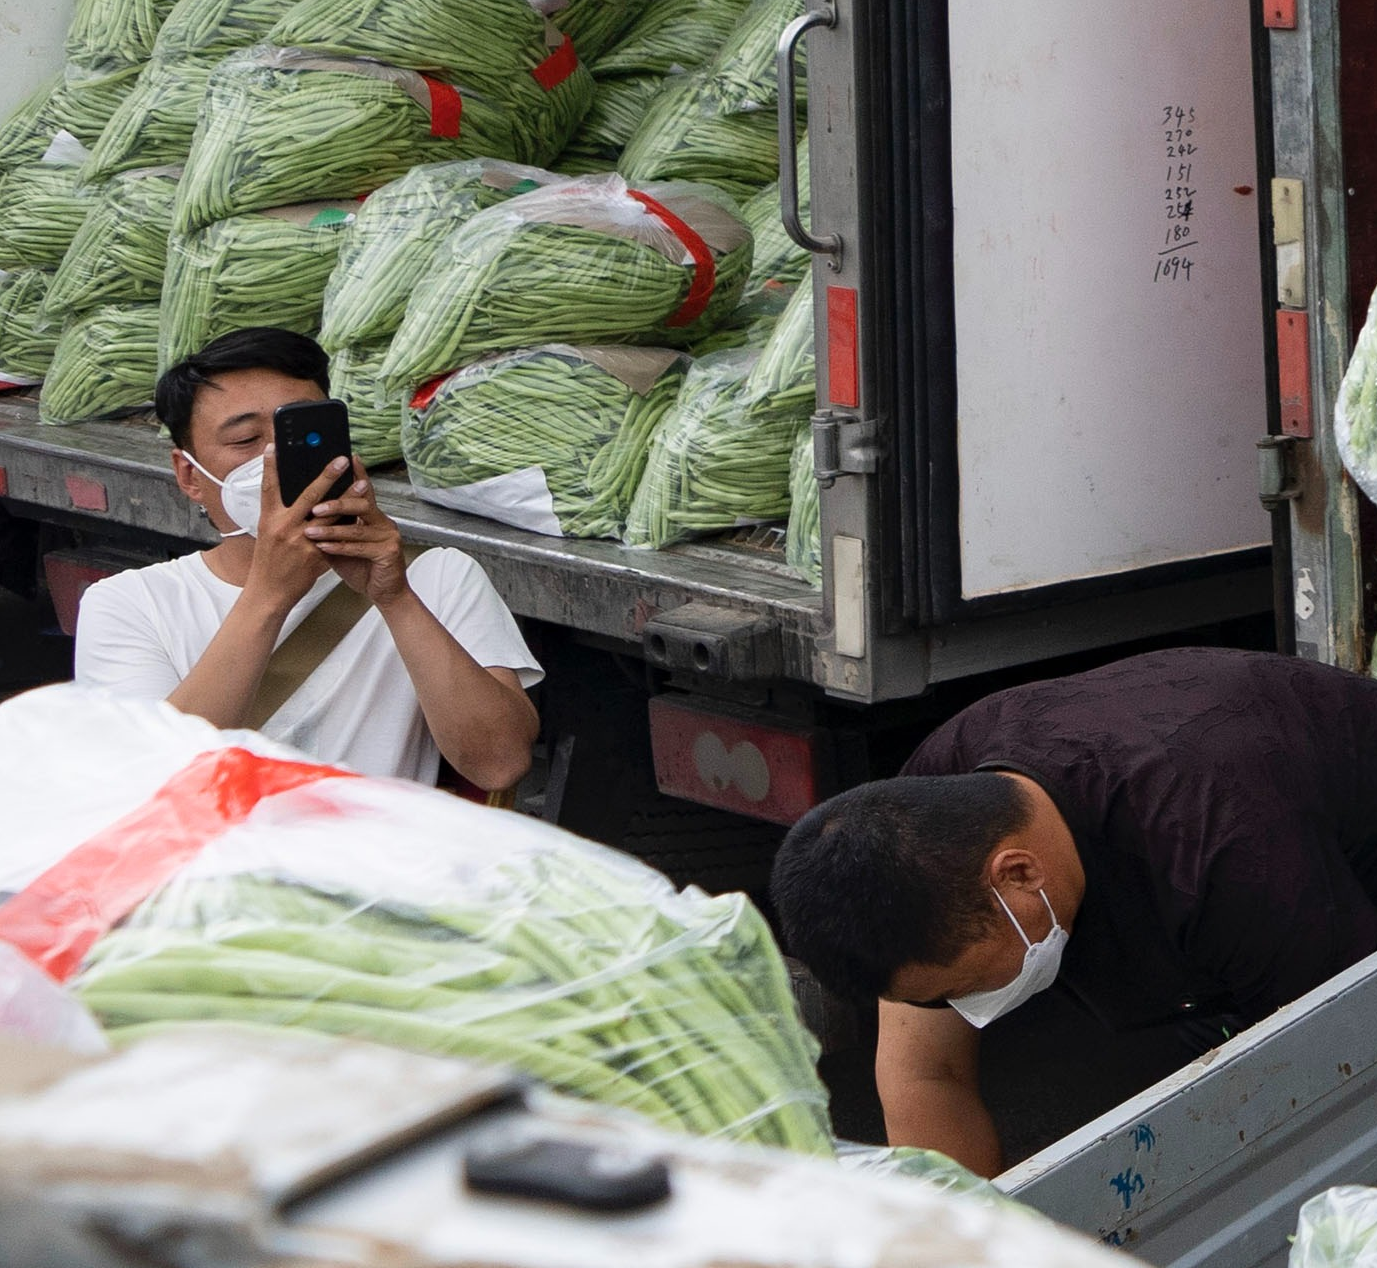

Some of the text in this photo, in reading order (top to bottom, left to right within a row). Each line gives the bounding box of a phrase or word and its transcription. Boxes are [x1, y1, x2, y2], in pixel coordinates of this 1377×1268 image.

[1162, 107, 1196, 128] 345
[1165, 129, 1193, 142] 270
[1166, 143, 1198, 158] 242
[1166, 163, 1192, 183] 151
[1165, 187, 1197, 200] 252
[1165, 225, 1191, 245] 180
[1154, 256, 1195, 282] 1694
